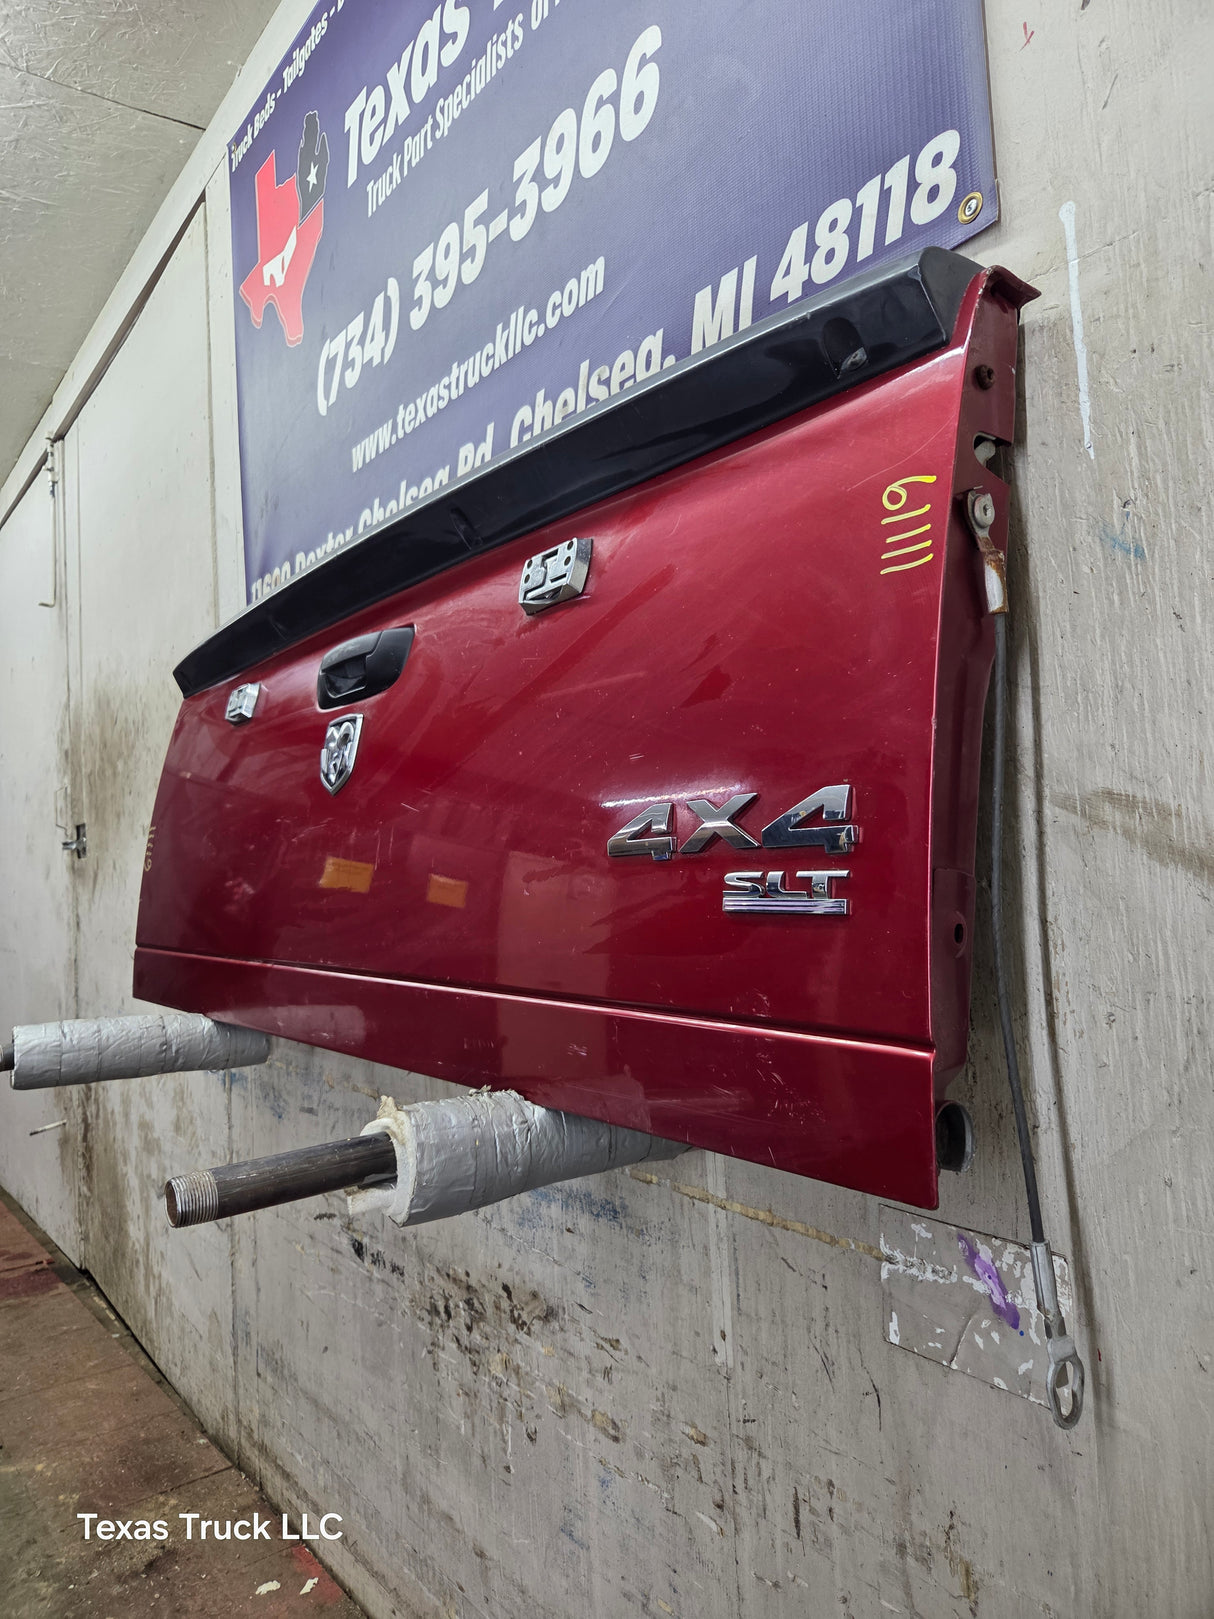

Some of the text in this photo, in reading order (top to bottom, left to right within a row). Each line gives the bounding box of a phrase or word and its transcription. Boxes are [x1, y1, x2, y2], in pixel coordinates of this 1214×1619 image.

[254, 93, 275, 139] Beds
[283, 12, 328, 93] Tailgates
[344, 0, 470, 188] Texas
[366, 143, 401, 218] Truck
[402, 118, 433, 180] Part
[435, 12, 524, 143] Specialists
[317, 25, 662, 416] (734) 395-3966
[691, 255, 757, 356] MI
[770, 129, 961, 303] 48118
[352, 256, 605, 474] www.texastruckllc.com
[723, 869, 850, 900] SLT
